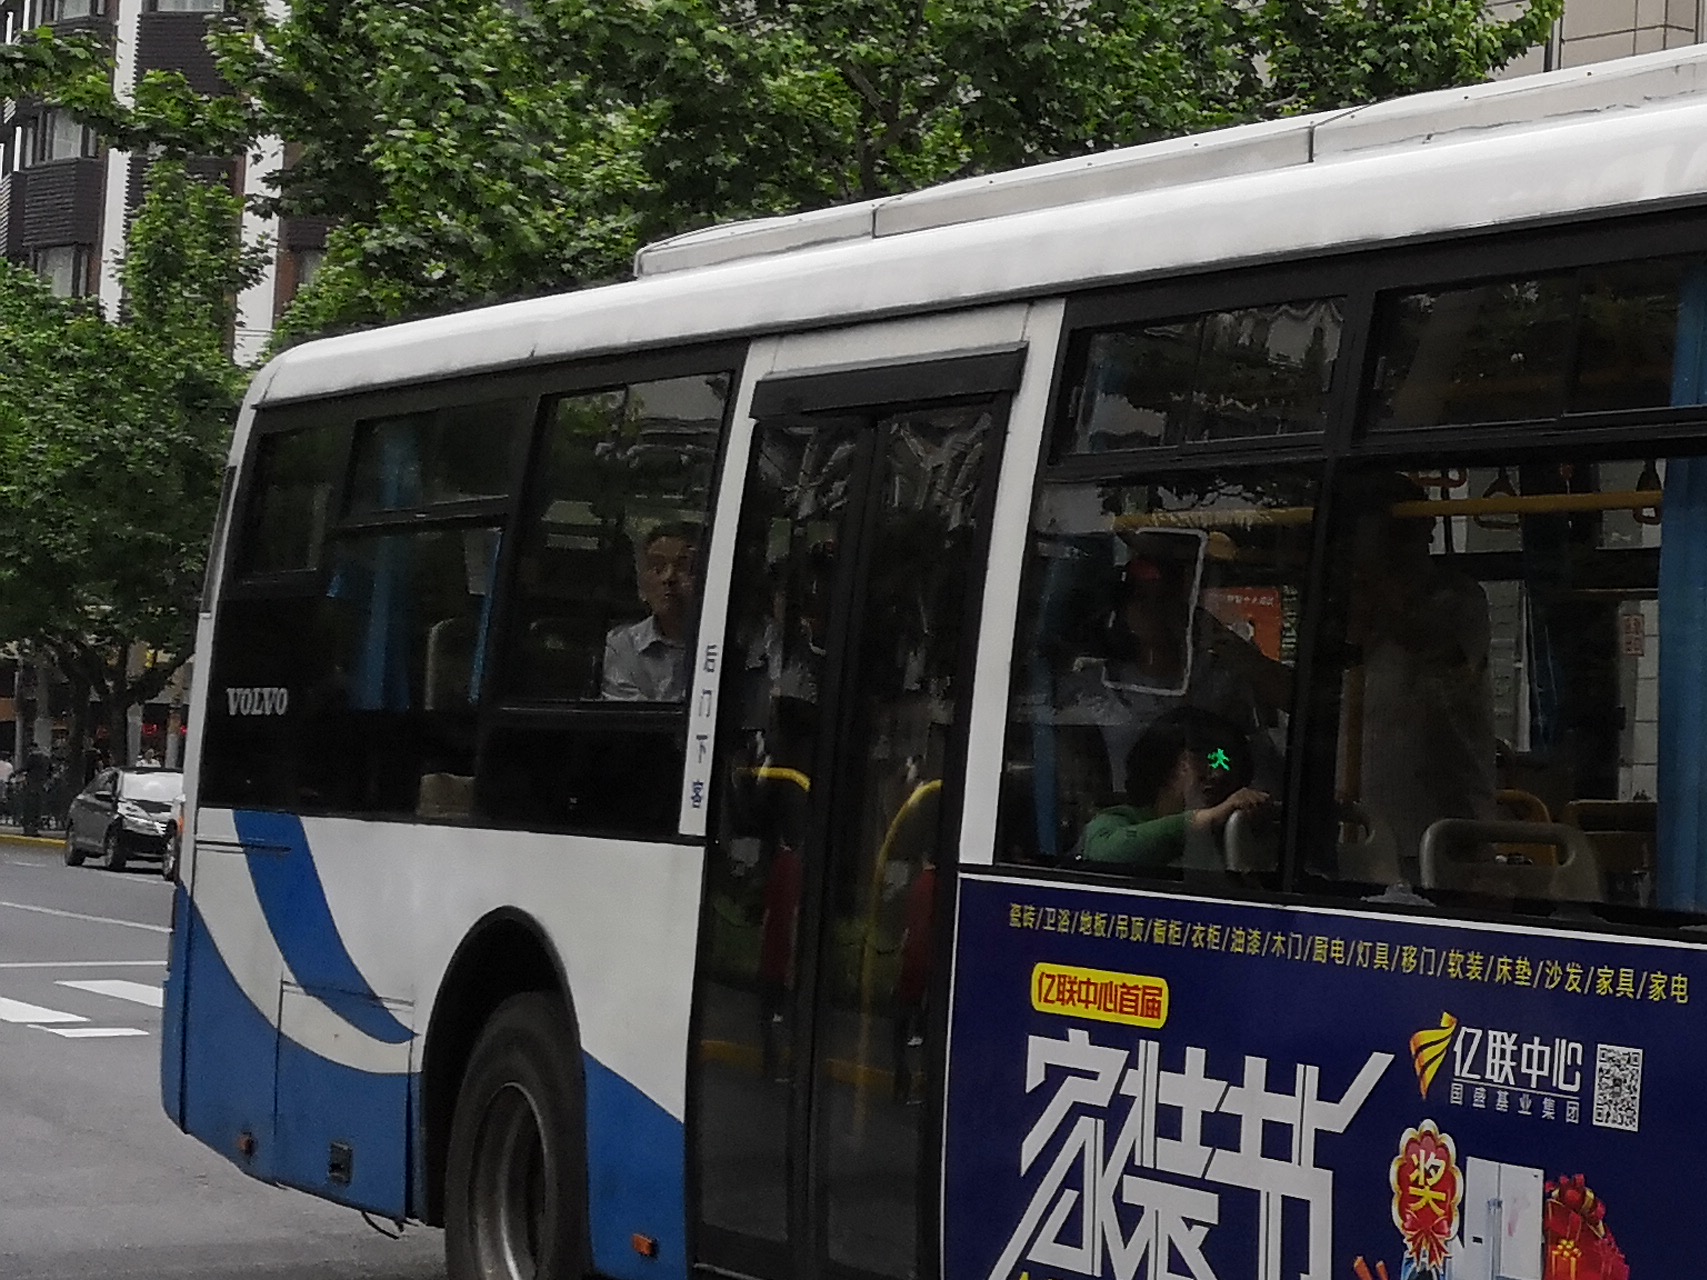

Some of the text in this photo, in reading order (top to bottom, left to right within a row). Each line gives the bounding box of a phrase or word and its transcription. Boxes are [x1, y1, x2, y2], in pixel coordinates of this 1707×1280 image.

[226, 687, 289, 716] VOLVO
[1037, 971, 1163, 1020] 亿联中心首届
[1452, 1026, 1583, 1093] 亿联中心
[1450, 1082, 1580, 1125] 国盛基业集团
[1409, 1148, 1447, 1216] 奖
